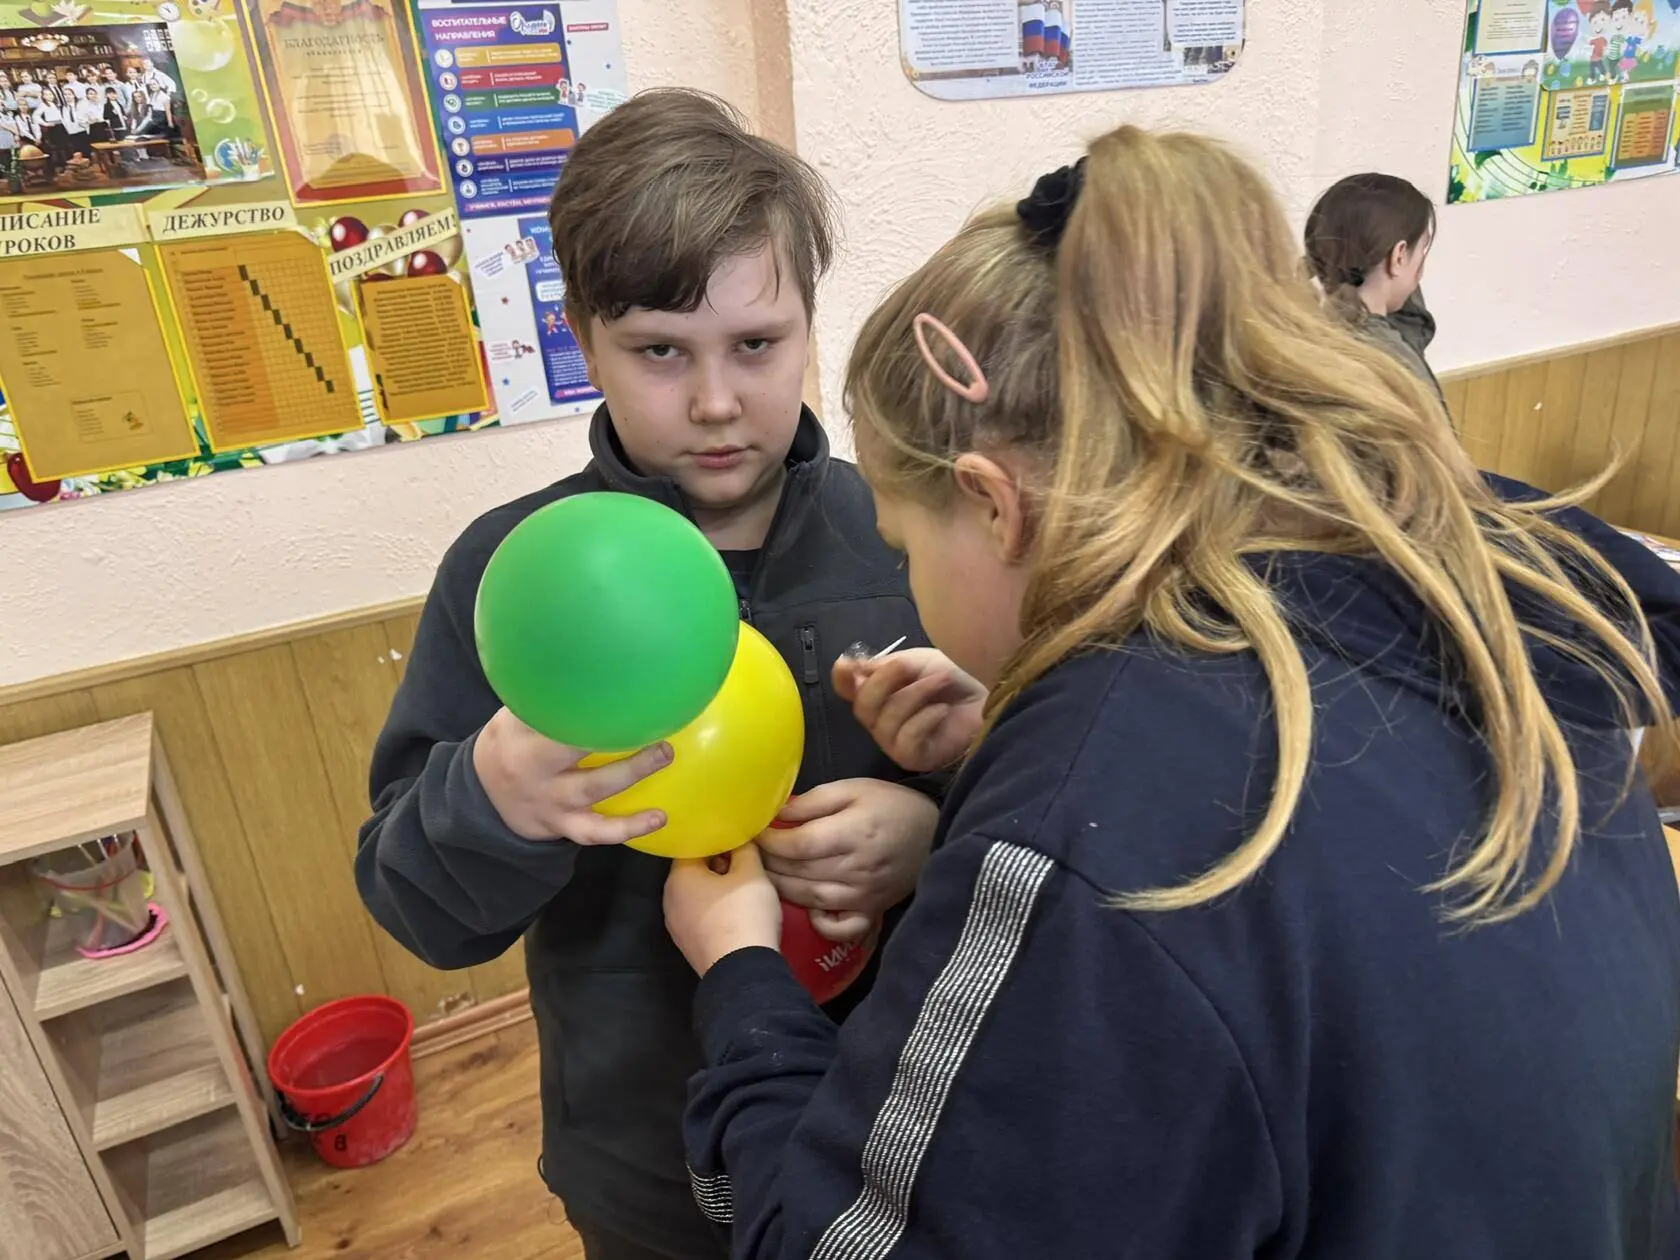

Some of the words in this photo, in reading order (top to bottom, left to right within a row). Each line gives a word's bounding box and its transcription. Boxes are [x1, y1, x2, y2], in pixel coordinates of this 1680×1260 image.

[431, 16, 507, 28] ВОСПИТАТЕЛЬНЫЕ
[435, 30, 496, 40] НАПРАВЛЕНИЯ
[163, 206, 285, 234] ДЕЖУРСТВО
[0, 234, 76, 254] РОКОВ
[330, 213, 457, 276] ПОЗДРАВЛЯЕМ!
